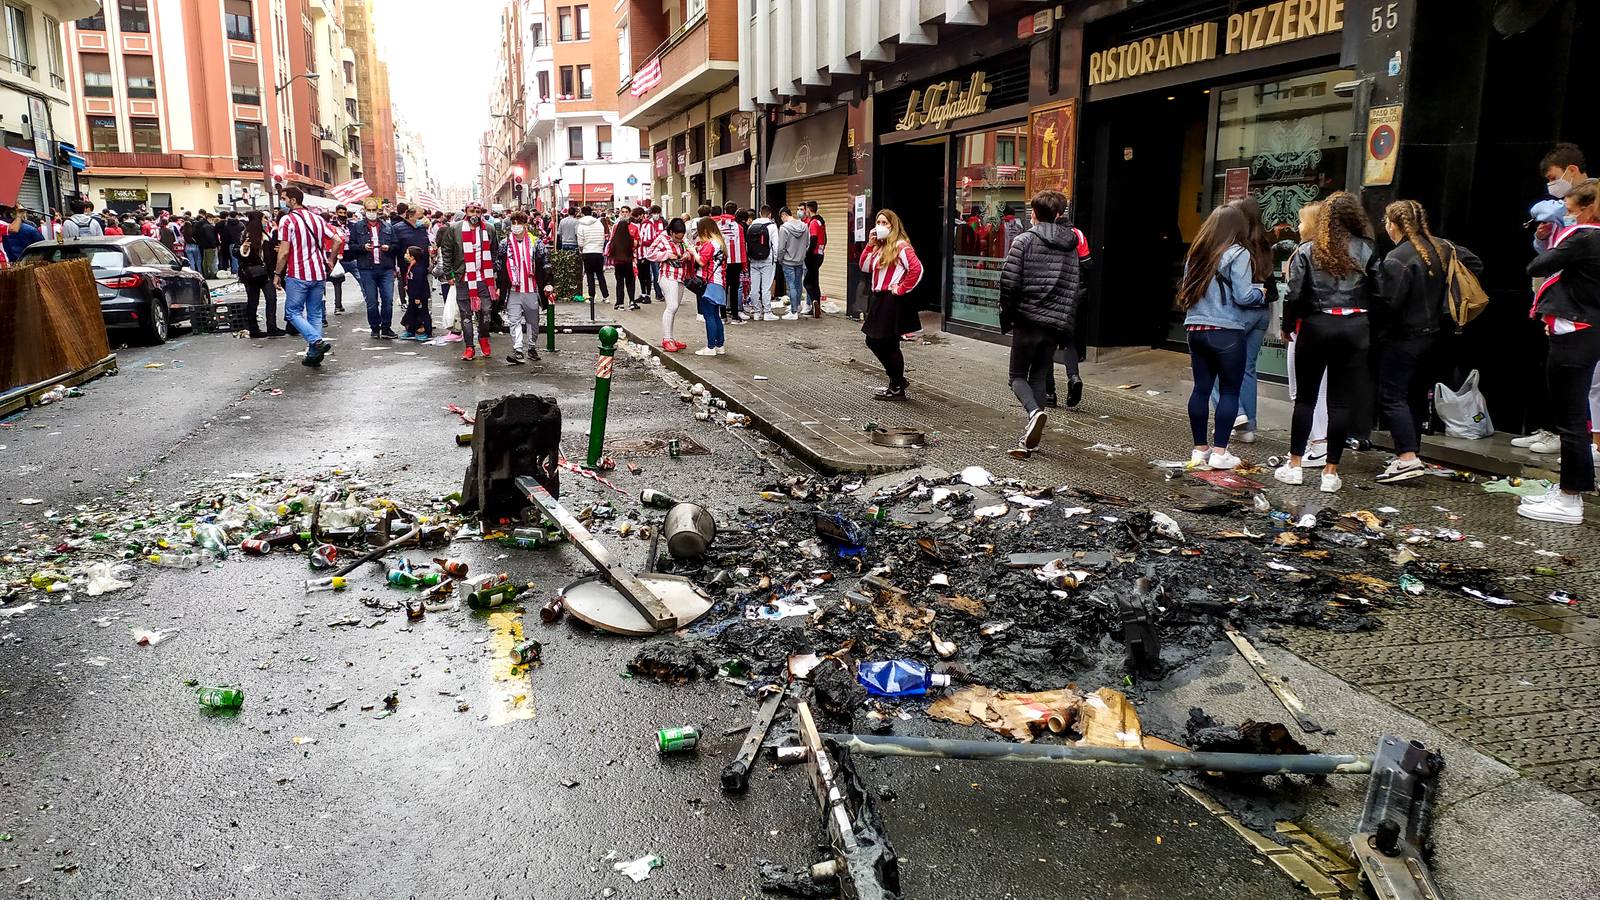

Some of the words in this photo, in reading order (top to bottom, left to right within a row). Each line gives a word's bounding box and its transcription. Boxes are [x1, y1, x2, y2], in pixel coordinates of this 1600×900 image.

[1371, 2, 1399, 33] 55
[1088, 21, 1214, 86] RISTORANTI
[1224, 0, 1344, 55] PIZZERIE
[896, 89, 917, 131] La
[919, 70, 987, 130] Tagliatella
[1373, 109, 1388, 118] PASO
